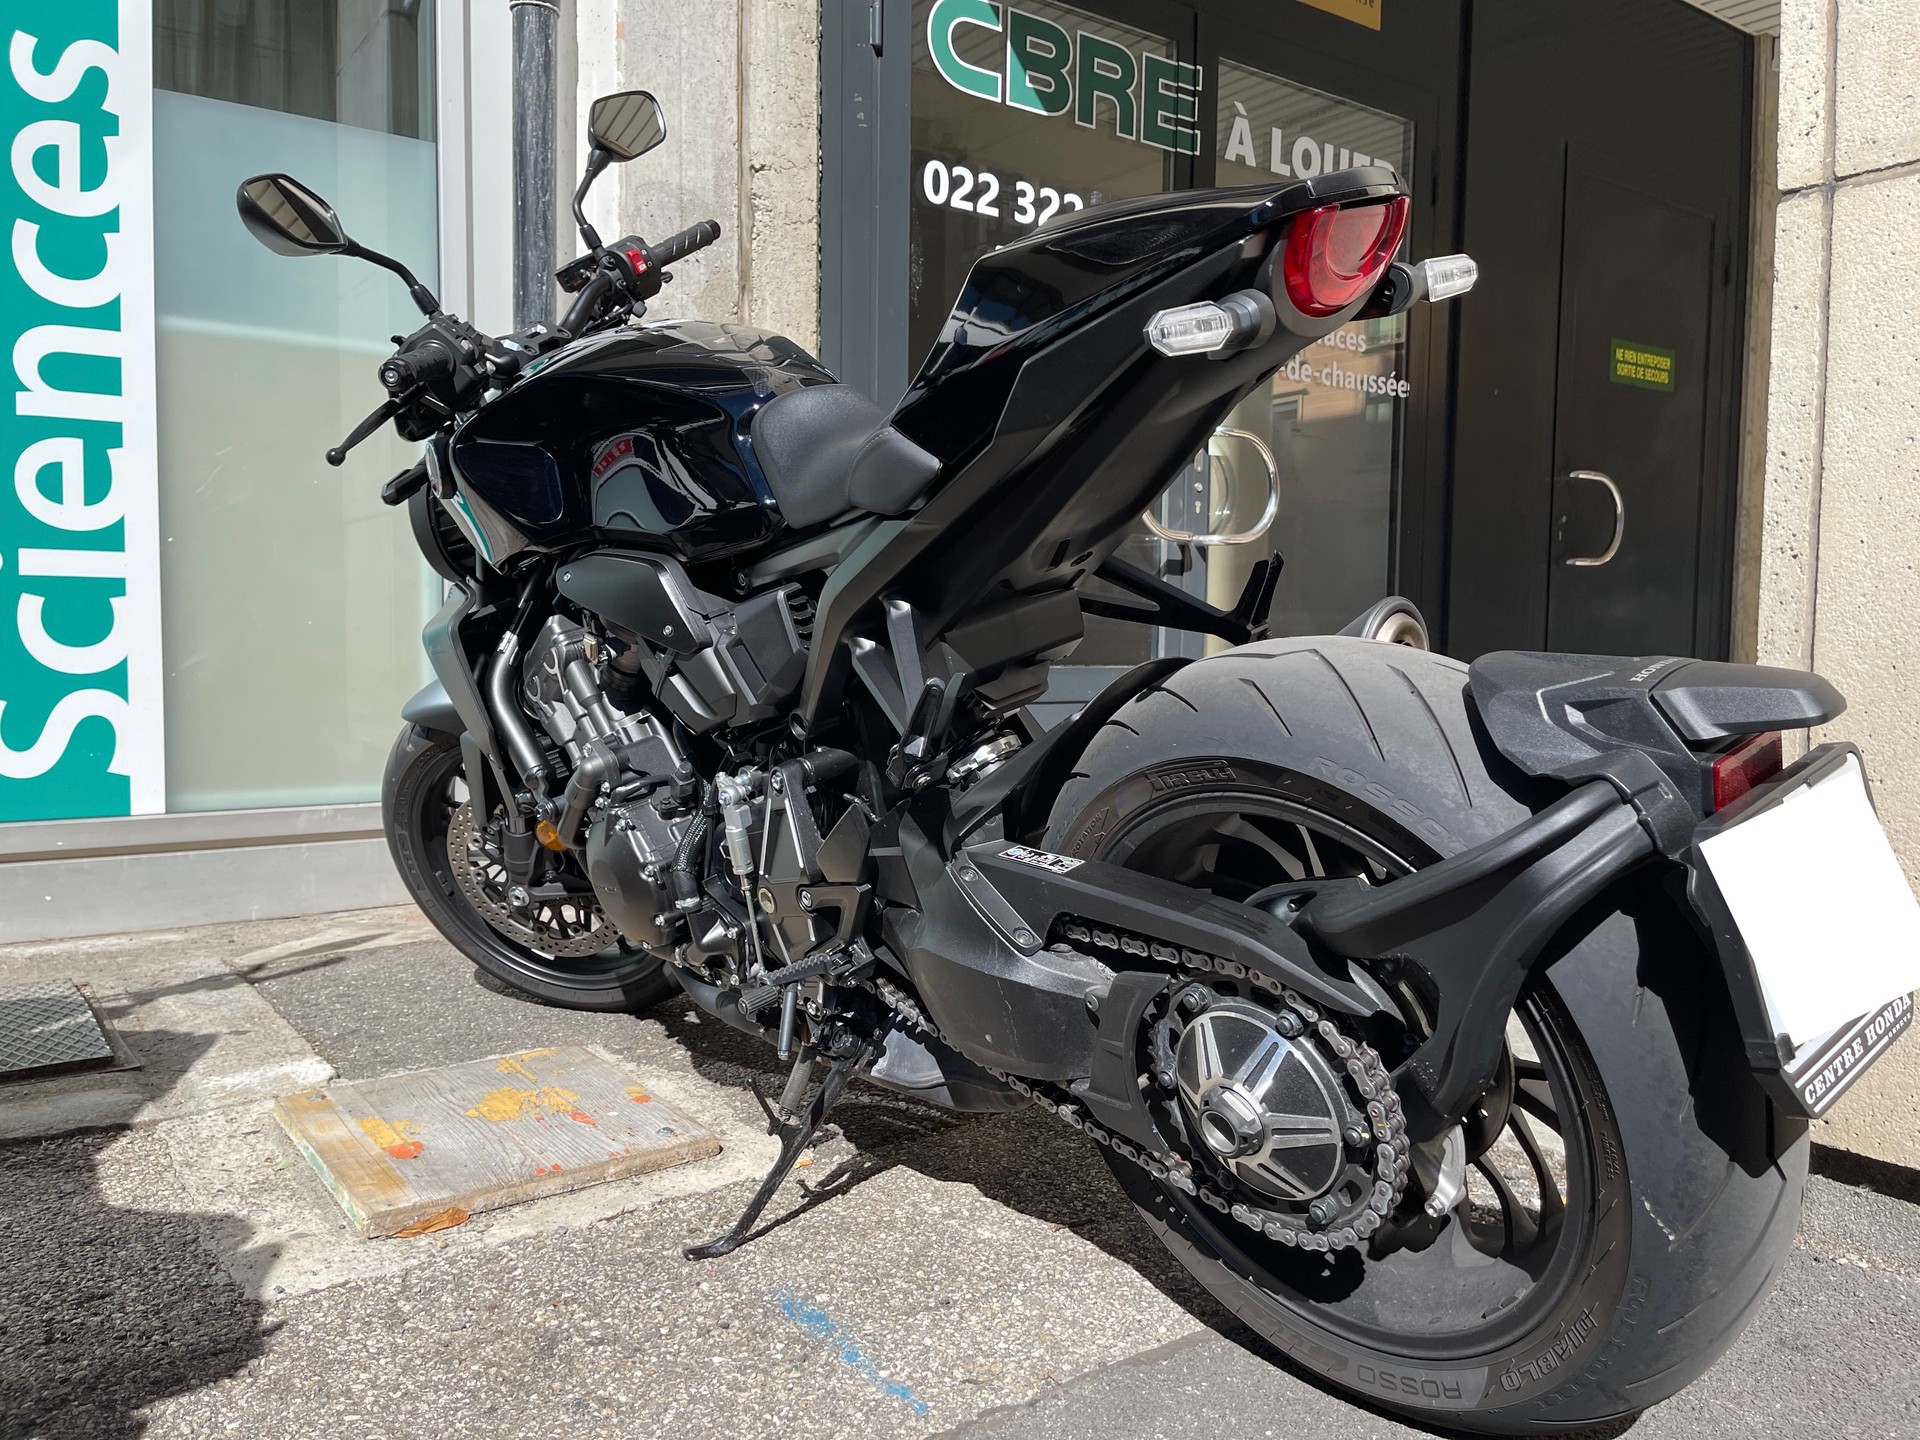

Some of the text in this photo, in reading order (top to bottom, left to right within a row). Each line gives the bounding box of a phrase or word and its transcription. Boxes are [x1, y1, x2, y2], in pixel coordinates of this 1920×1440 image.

[927, 0, 1203, 156] CBRE
[1224, 101, 1257, 167] À
[923, 160, 1000, 218] 022
[1615, 347, 1671, 370] NE RIEN ENTREPOSER
[1616, 362, 1669, 384] SORTIE DE SECOURS
[0, 29, 131, 780] Sciences
[1307, 754, 1451, 842] ROSSO
[1804, 993, 1911, 1105] CENTRE HONDA
[1357, 1363, 1463, 1400] ROSSO
[1500, 1308, 1598, 1393] DIABLO
